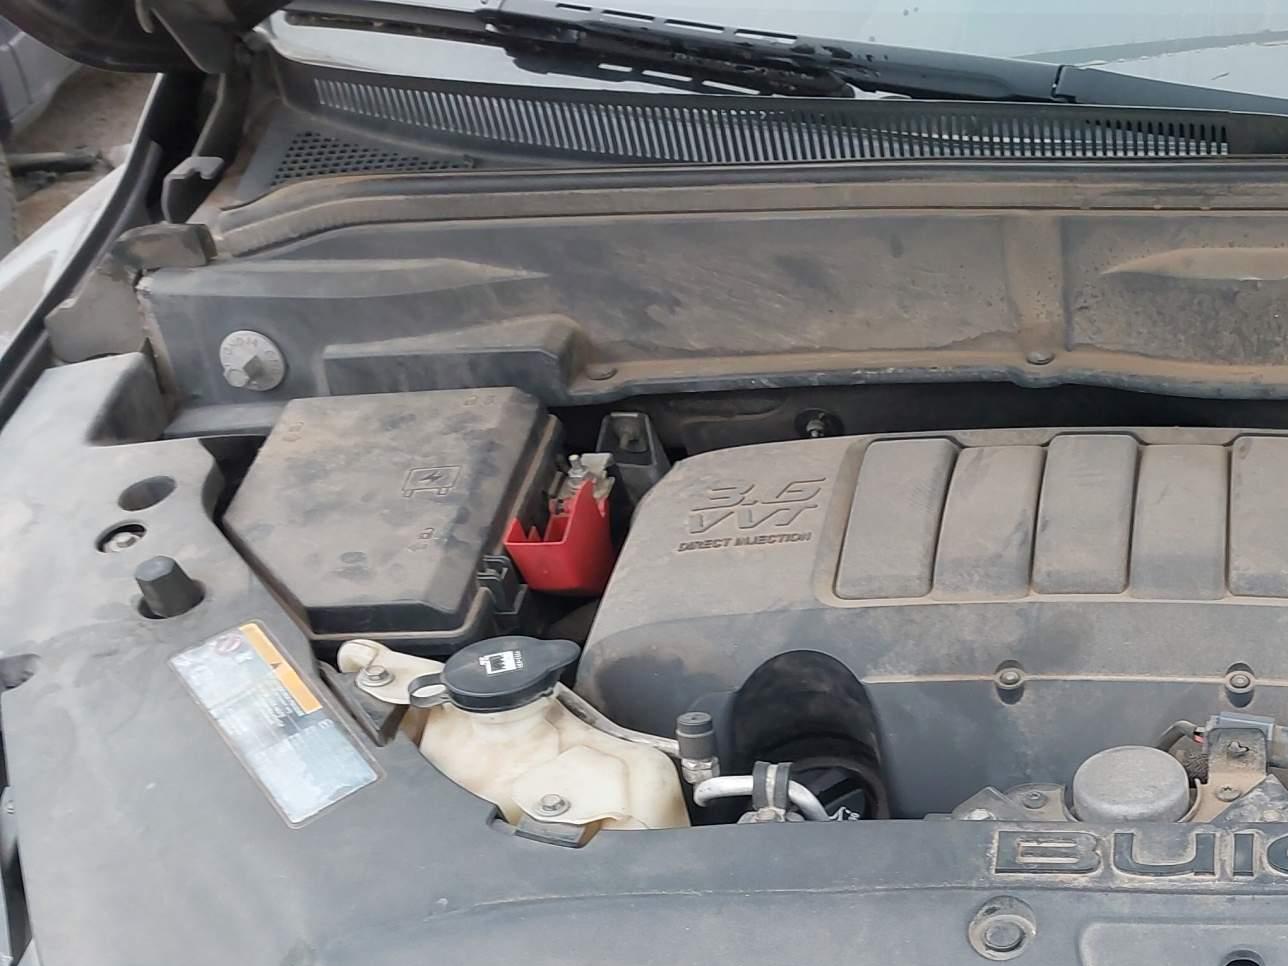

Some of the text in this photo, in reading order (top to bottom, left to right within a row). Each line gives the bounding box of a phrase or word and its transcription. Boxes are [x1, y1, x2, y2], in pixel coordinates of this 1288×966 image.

[690, 477, 827, 512] 3.6
[688, 502, 819, 535] VVT
[677, 531, 813, 552] DIRECT INJECTION
